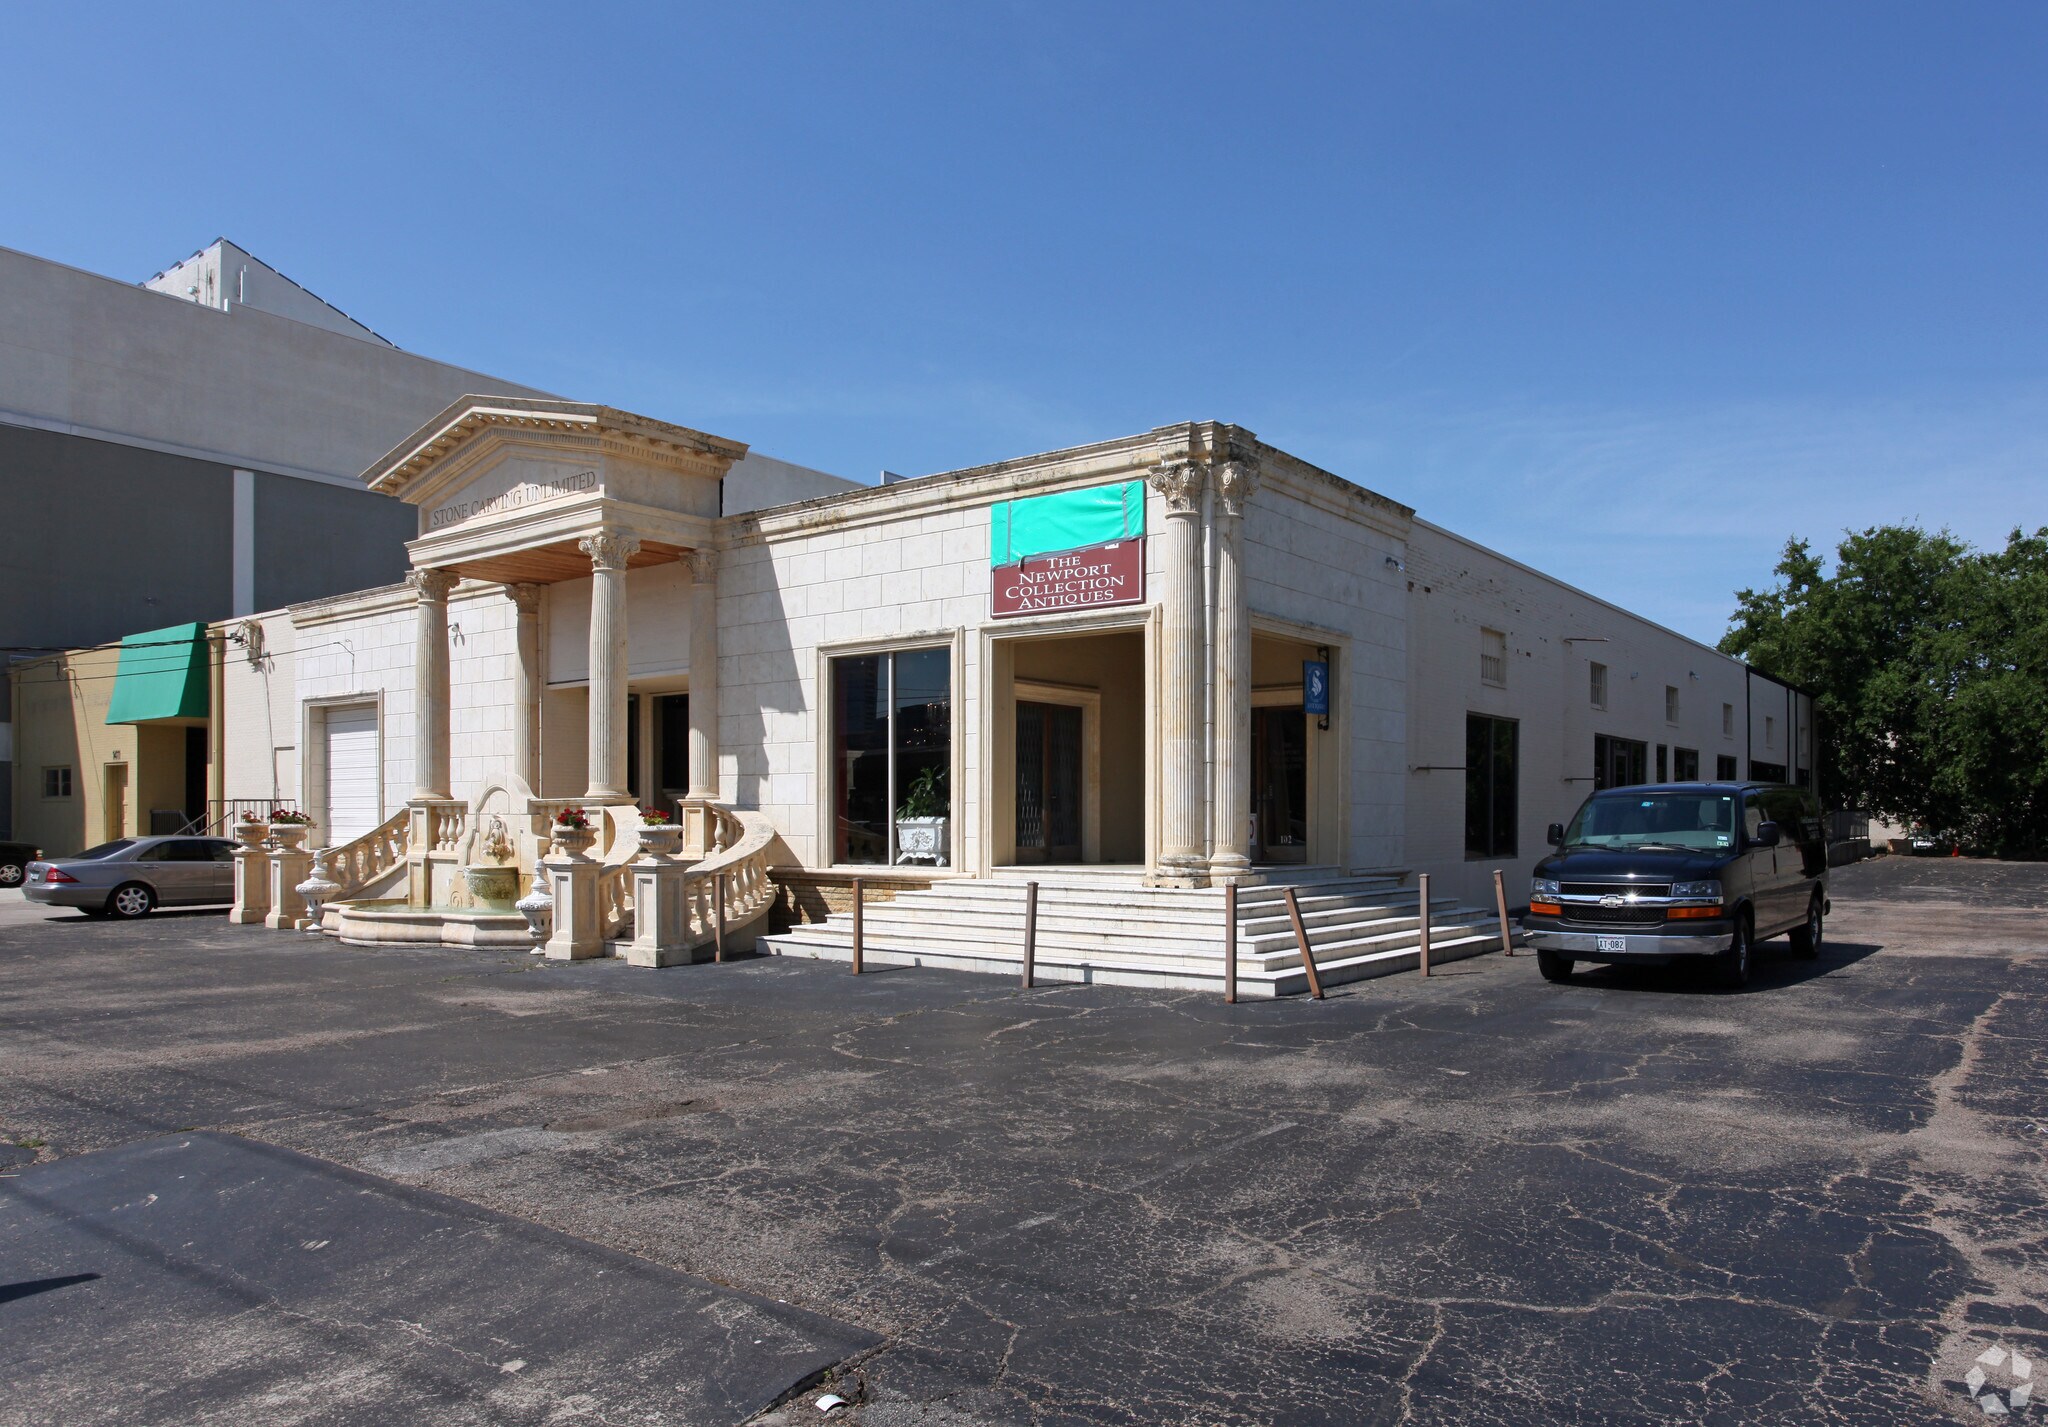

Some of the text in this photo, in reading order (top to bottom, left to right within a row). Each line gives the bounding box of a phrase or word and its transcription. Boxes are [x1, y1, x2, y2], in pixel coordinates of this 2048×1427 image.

[433, 471, 596, 526] STONE CARVING UNLIMITED
[1047, 556, 1081, 569] THE
[1018, 564, 1112, 585] NEWPORT
[1005, 575, 1125, 599] COLLECTION
[1018, 589, 1114, 609] ANTIQUES
